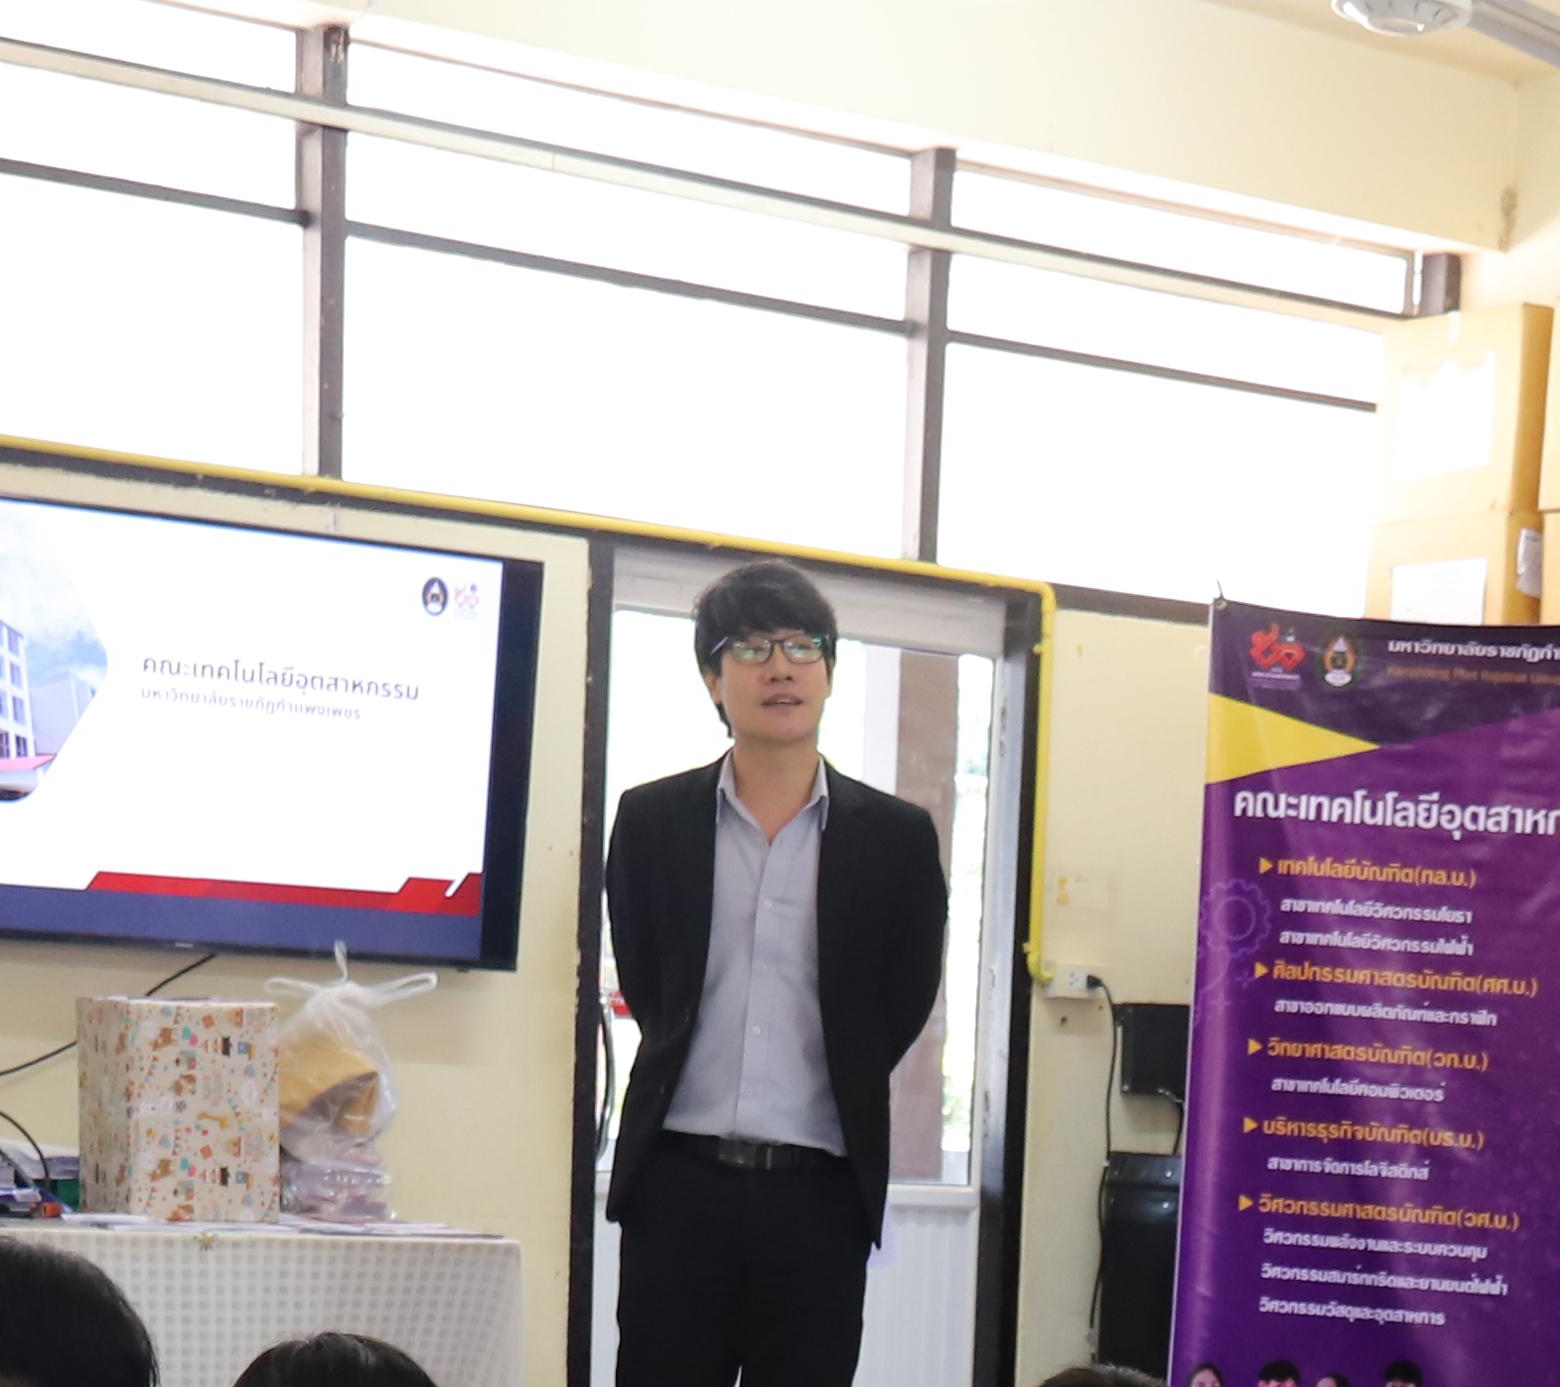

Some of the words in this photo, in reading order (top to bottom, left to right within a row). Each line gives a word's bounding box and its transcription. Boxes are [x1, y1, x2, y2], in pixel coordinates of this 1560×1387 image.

[142, 657, 420, 701] คณะเทคโนโลยีอุตสาหกรรม
[1277, 856, 1478, 889] เทคโนโลยีบัณฑิต(ทล.บ.)
[1267, 1037, 1488, 1072] วิทยาศาสตรบัณฑิต(วท.บ.)
[1263, 1116, 1485, 1151] บริหารธุรกิจบัณฑิต(บธ.บ.)
[1258, 1194, 1520, 1232] วิศวกรรมศาสตรบัณฑิต(วศ.บ.)
